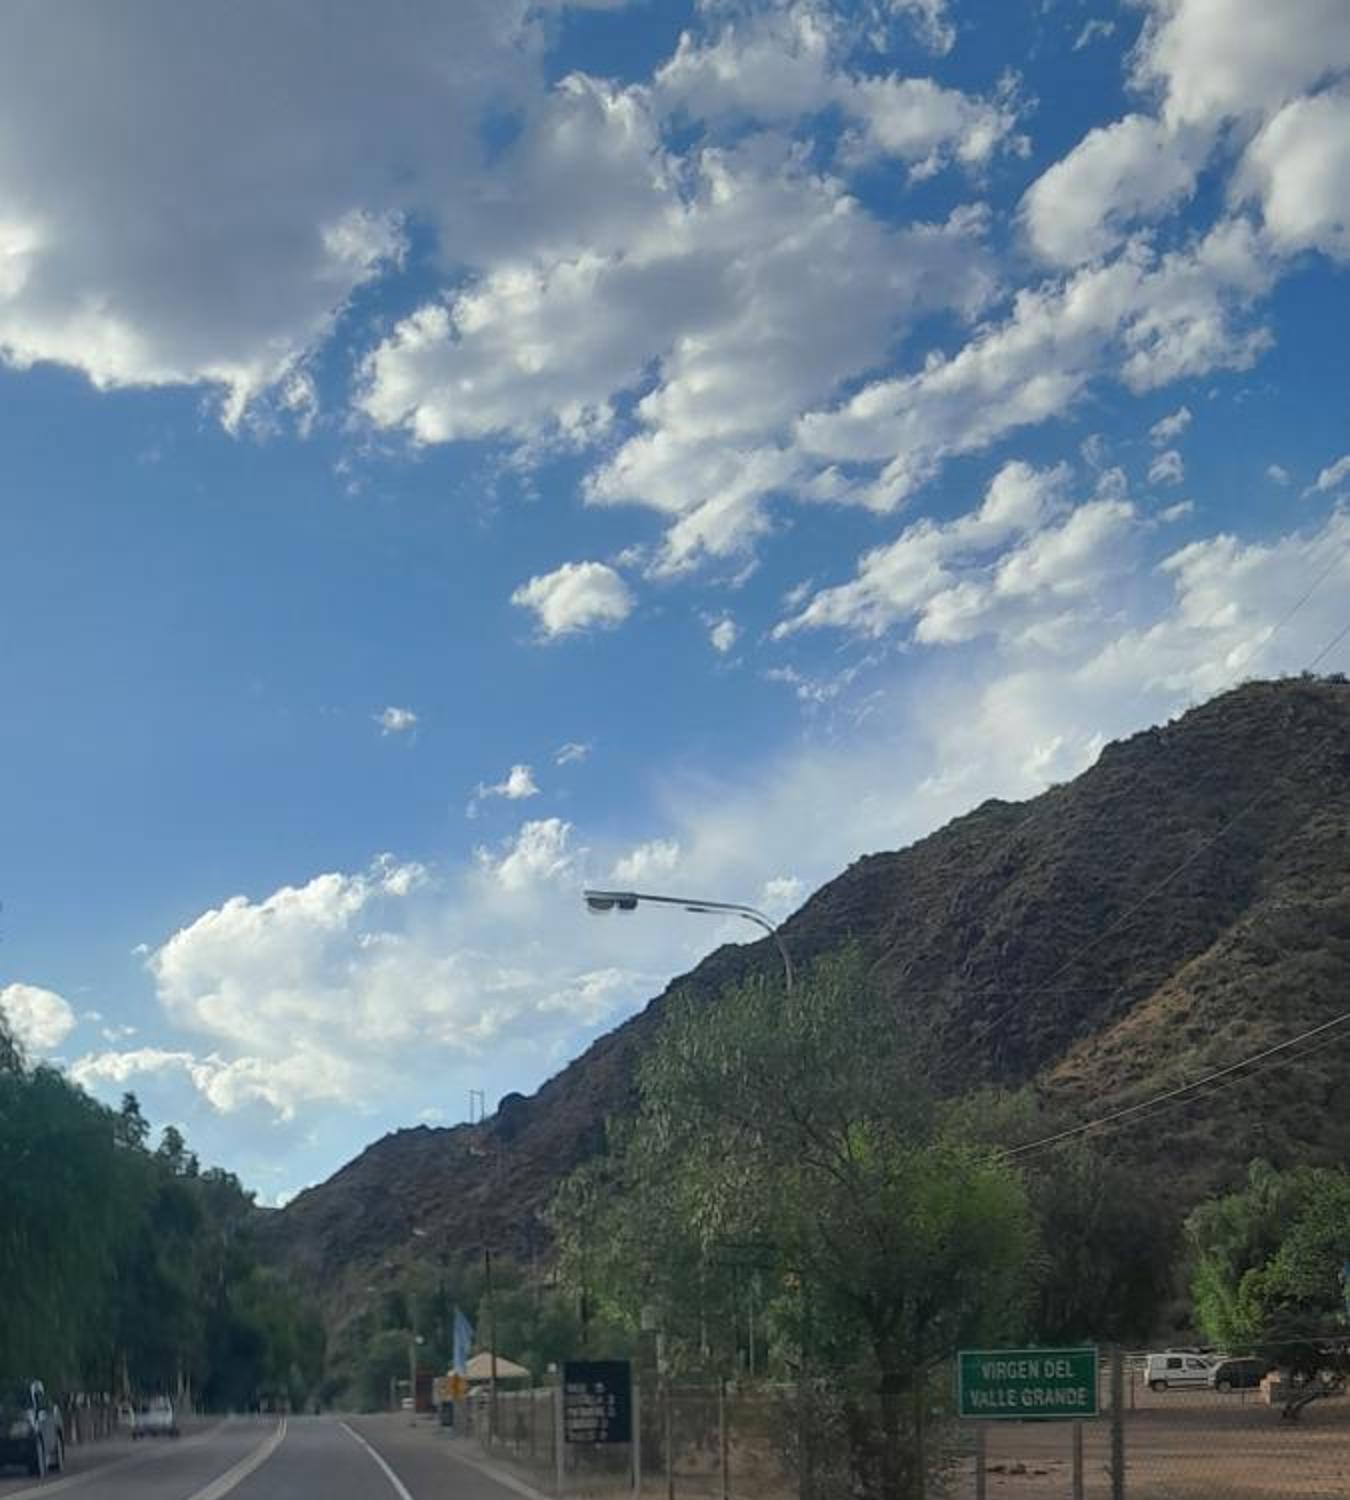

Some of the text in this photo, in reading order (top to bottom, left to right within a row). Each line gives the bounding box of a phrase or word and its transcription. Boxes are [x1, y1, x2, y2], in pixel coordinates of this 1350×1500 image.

[981, 1360, 1073, 1379] VIRGEN DEL
[969, 1387, 1088, 1408] VALLE GRANDE
